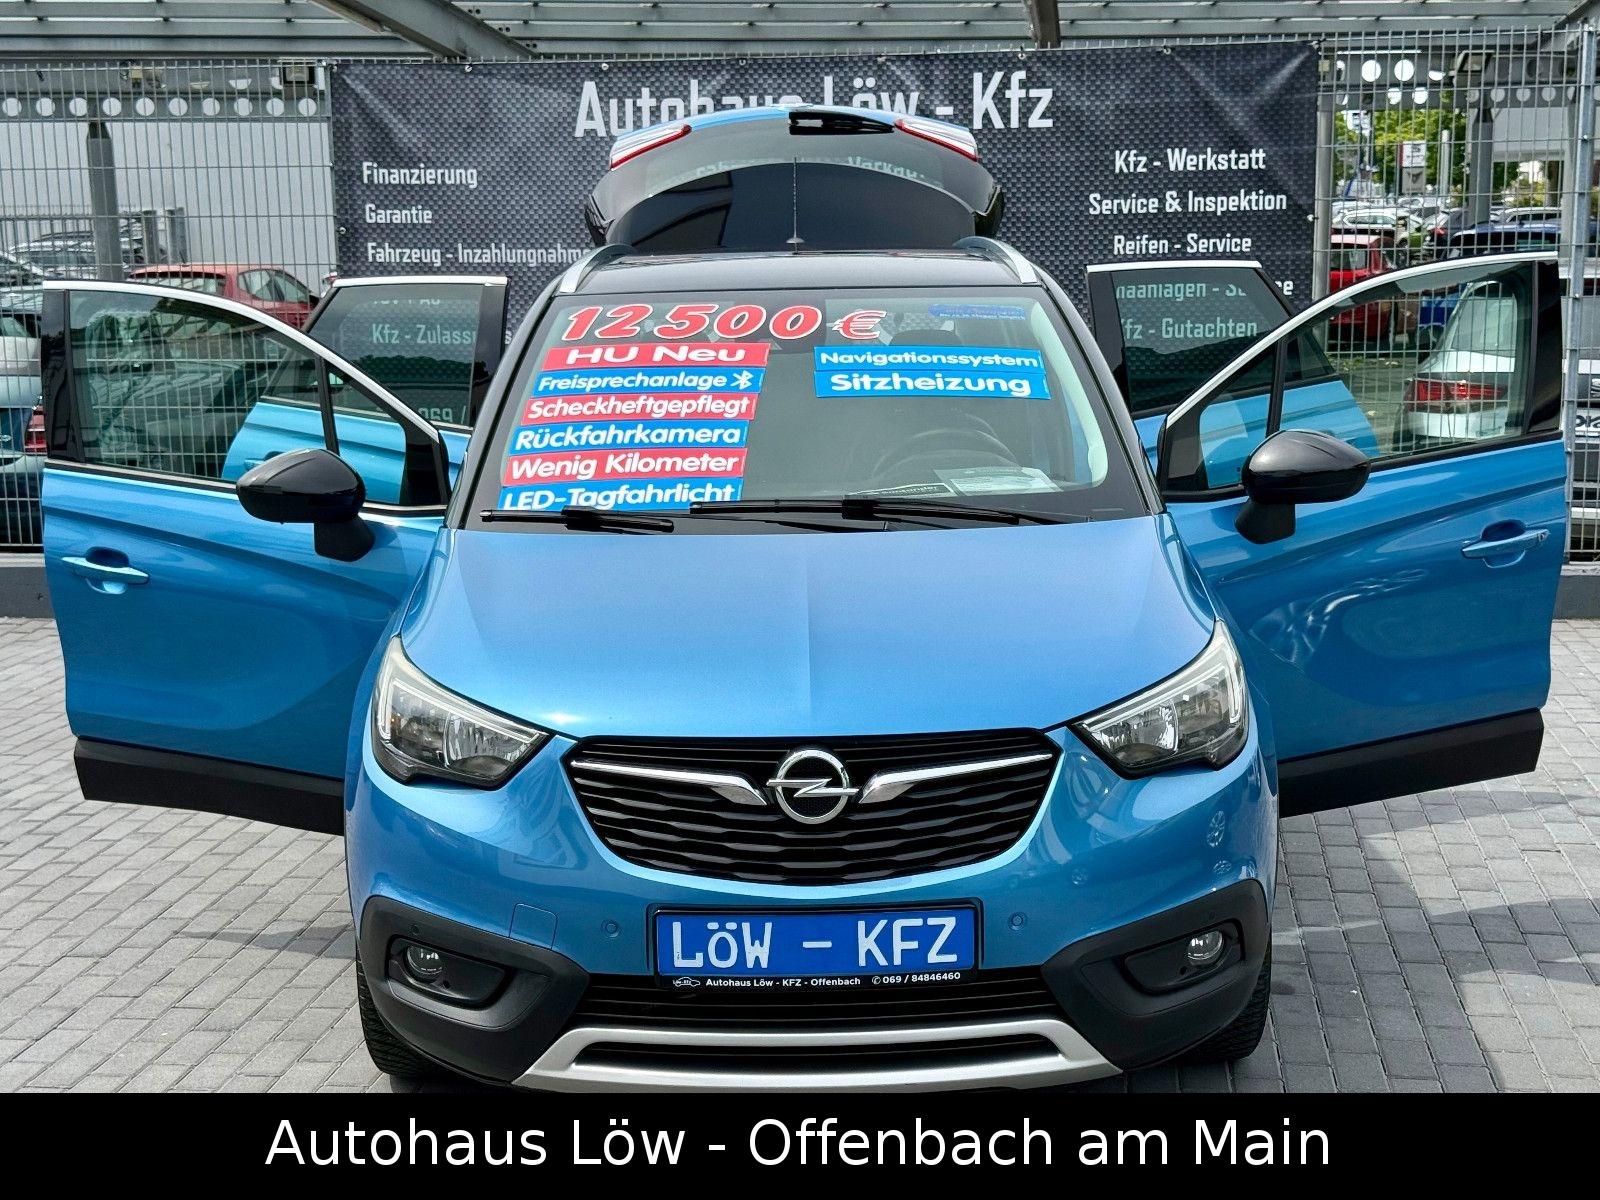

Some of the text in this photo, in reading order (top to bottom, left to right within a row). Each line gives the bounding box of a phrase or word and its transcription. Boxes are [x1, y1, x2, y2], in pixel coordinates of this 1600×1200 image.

[574, 79, 803, 138] Autoh
[973, 71, 1053, 129] Kfz
[1114, 150, 1148, 174] Kfz
[1167, 148, 1266, 172] Werkstatt
[362, 161, 478, 189] Finanzierung
[365, 204, 433, 225] Garantie
[1089, 189, 1287, 216] Service & Inspektion
[367, 242, 441, 267] Fahrzeug
[1113, 234, 1169, 256] Reifen
[1187, 233, 1251, 253] Service
[372, 324, 400, 345] Kfz
[831, 310, 887, 340] €
[1121, 319, 1143, 340] fz
[1162, 317, 1258, 339] Gutachten
[566, 345, 746, 365] HU Neu
[820, 351, 1039, 369] Navigationssystem
[537, 371, 728, 392] Freisprechanlage
[830, 372, 1032, 397] Sitzheizung
[527, 394, 750, 419] Scheckheftgepflegt
[515, 423, 741, 450] Rückfahrkamera
[511, 453, 739, 480] Wenig Kilometer
[503, 483, 735, 511] LED-Tagfahrlicht
[857, 916, 958, 967] KFZ
[705, 979, 751, 987] Autohaus
[753, 978, 773, 987] Löw
[782, 979, 801, 987] KFZ
[810, 977, 861, 986] Offenbach
[882, 975, 902, 984] 069
[911, 971, 961, 982] 84846460
